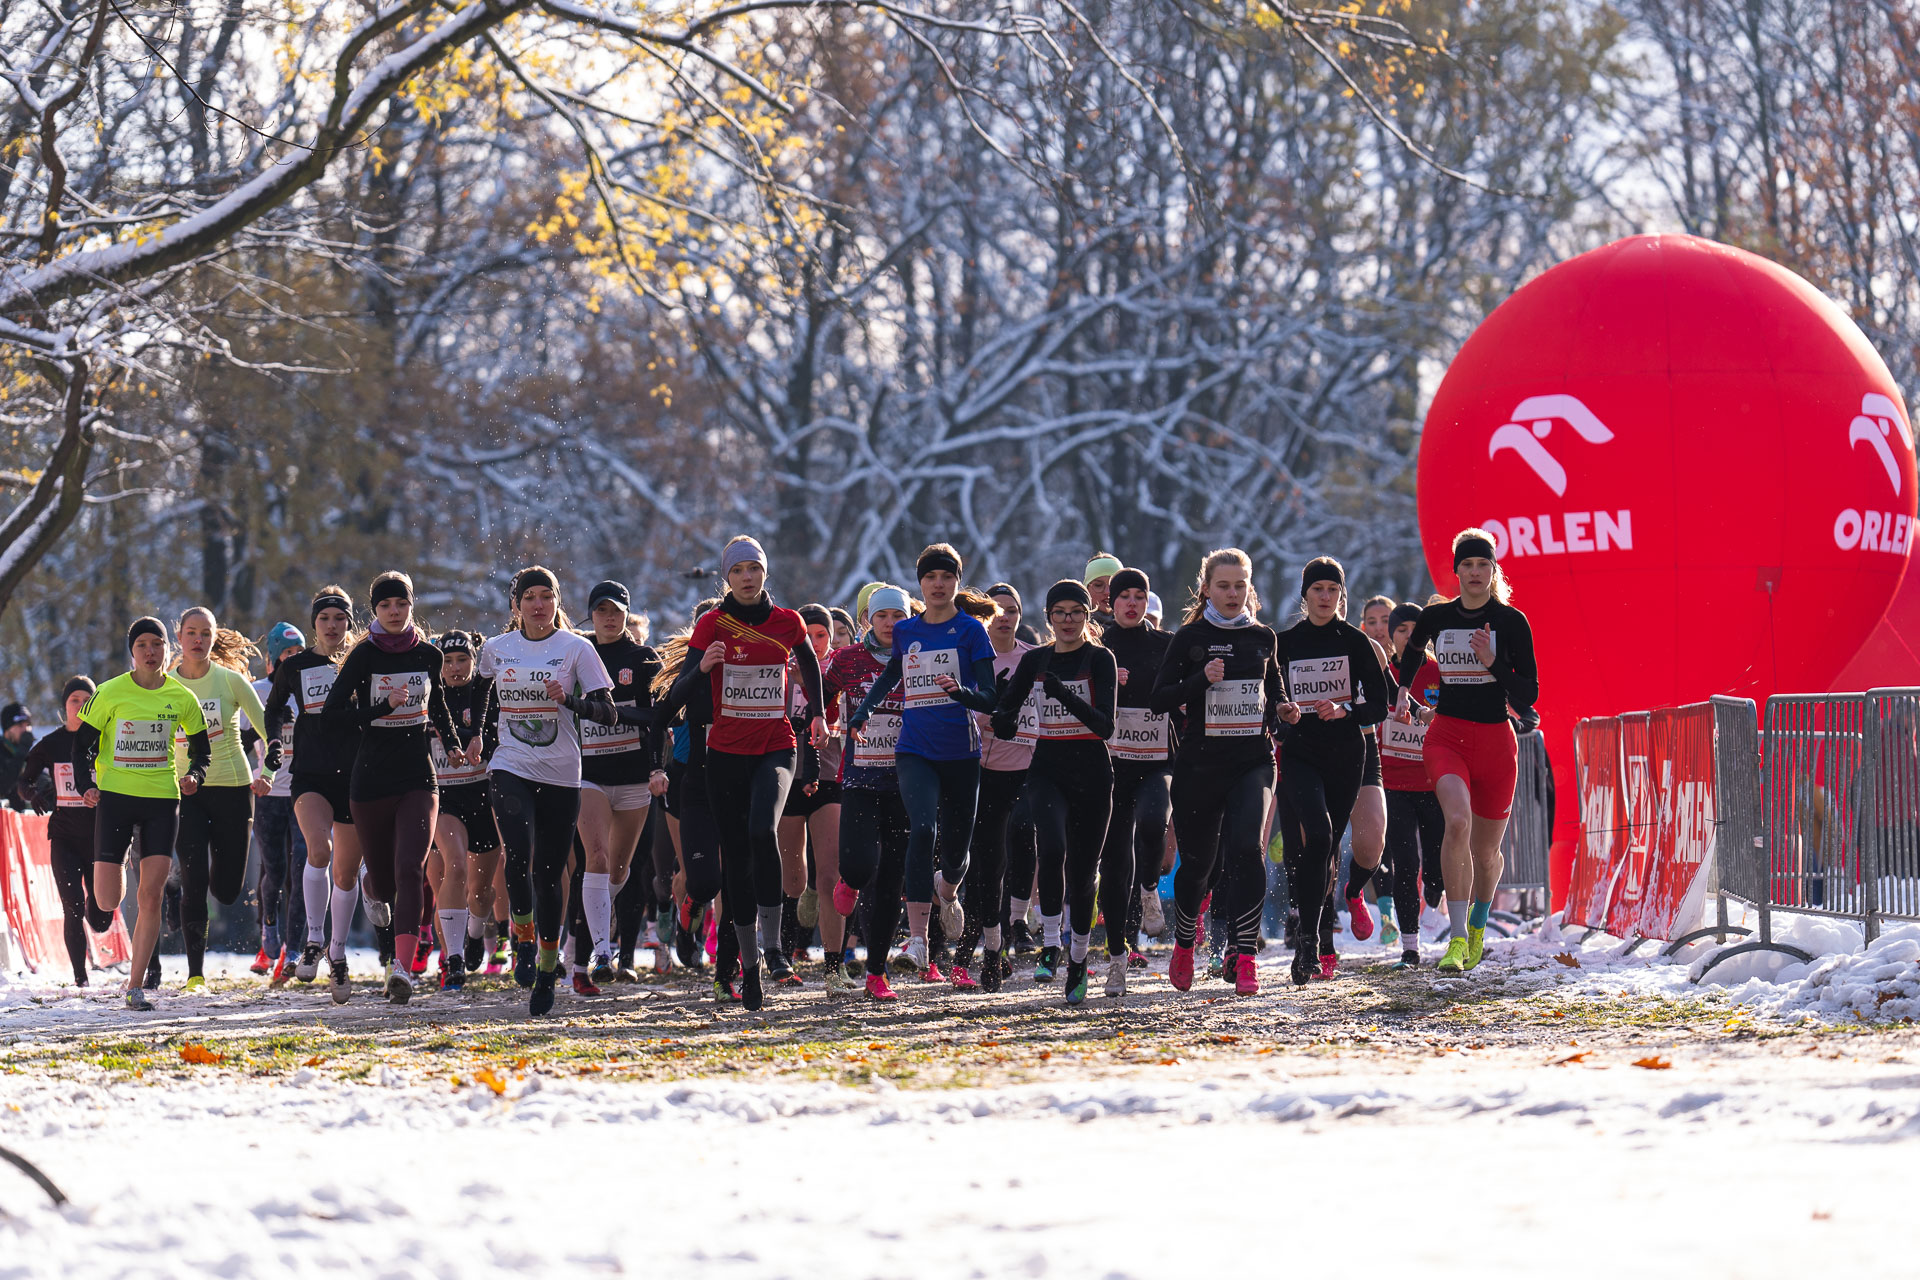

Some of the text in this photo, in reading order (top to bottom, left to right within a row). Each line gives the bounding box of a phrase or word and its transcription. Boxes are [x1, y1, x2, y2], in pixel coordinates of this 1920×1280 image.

[1834, 508, 1915, 557] ORLEN
[934, 653, 949, 664] 42
[1438, 652, 1484, 664] OLCHAW
[1321, 660, 1344, 672] 227
[529, 671, 552, 682] 102
[759, 668, 780, 679] 176
[408, 675, 422, 686] 48
[1293, 678, 1346, 695] BRUDNY
[307, 683, 335, 698] CZA
[725, 686, 782, 700] OPALCZYK
[1241, 683, 1260, 695] 576
[1043, 704, 1073, 720] ZIĘB
[1208, 703, 1234, 717] NOWAK
[1144, 711, 1164, 722] 503
[150, 723, 163, 733] 13
[1117, 728, 1159, 742] JAROŃ
[115, 739, 168, 752] ADAMCZEWSKA
